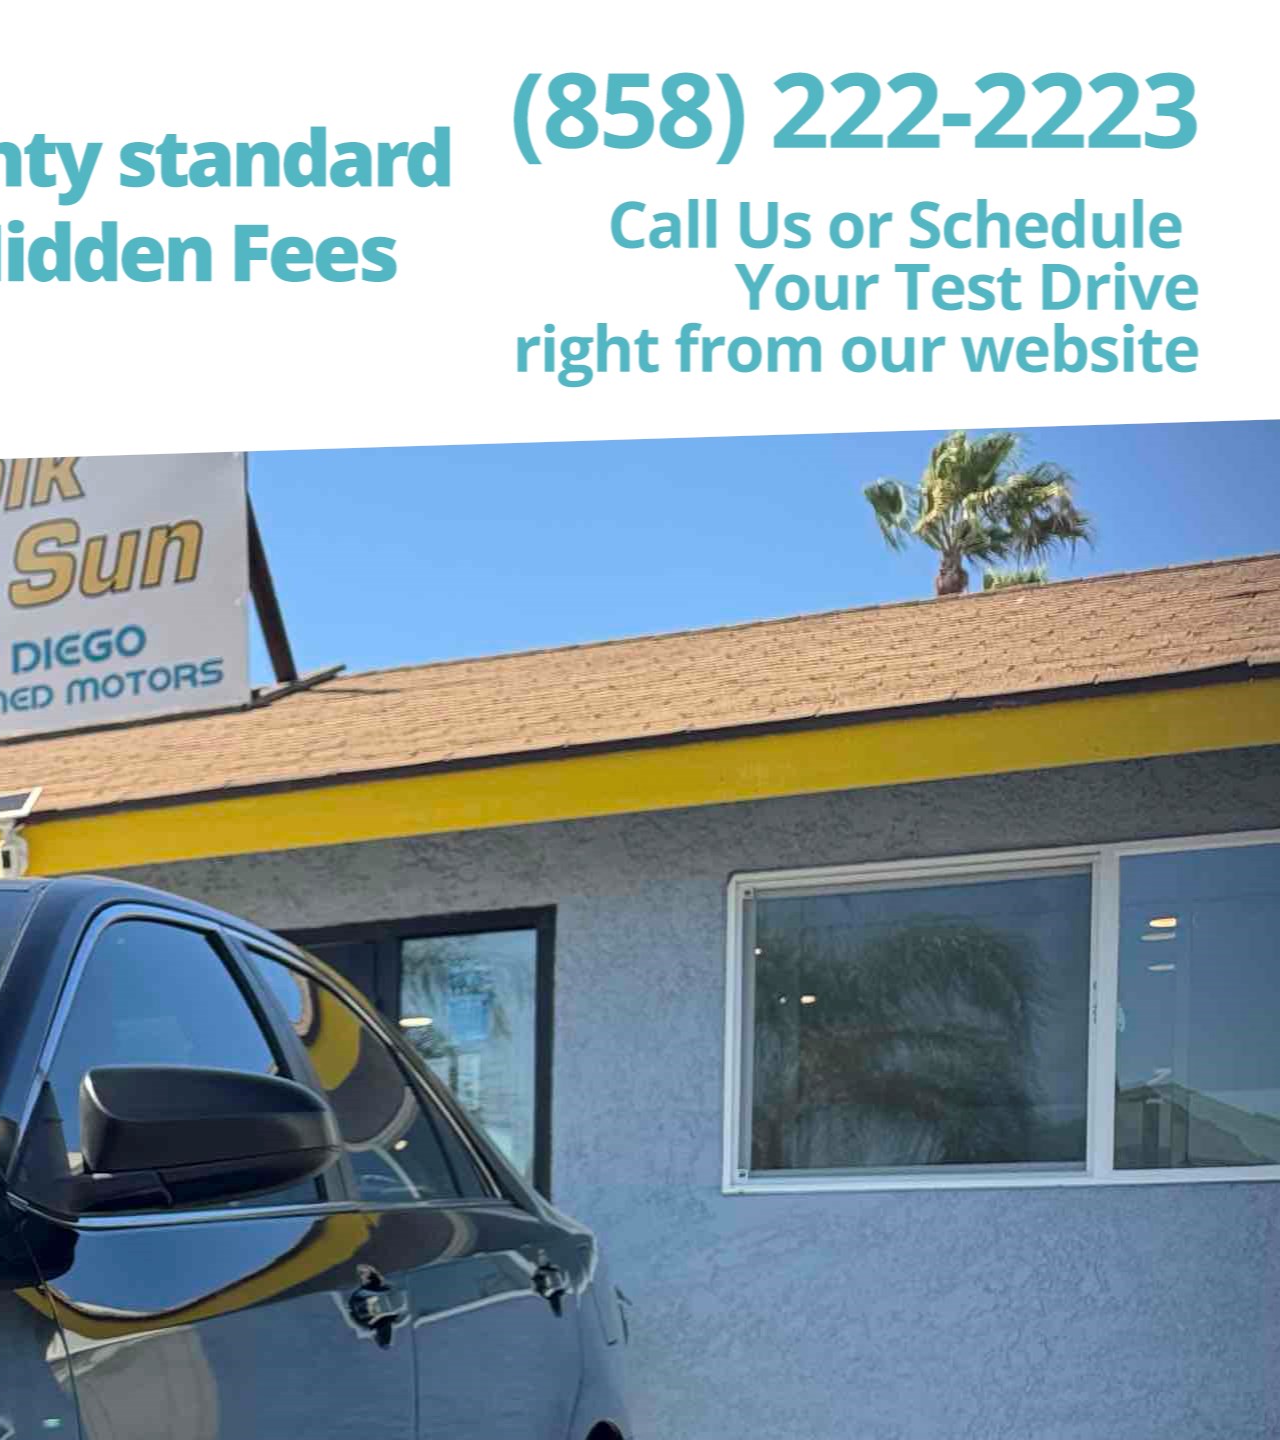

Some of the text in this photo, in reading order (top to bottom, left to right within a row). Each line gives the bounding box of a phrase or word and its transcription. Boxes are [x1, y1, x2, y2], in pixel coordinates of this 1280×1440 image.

[8, 518, 203, 609] Sun
[12, 625, 147, 675] DIEGO
[67, 658, 224, 704] MOTORS
